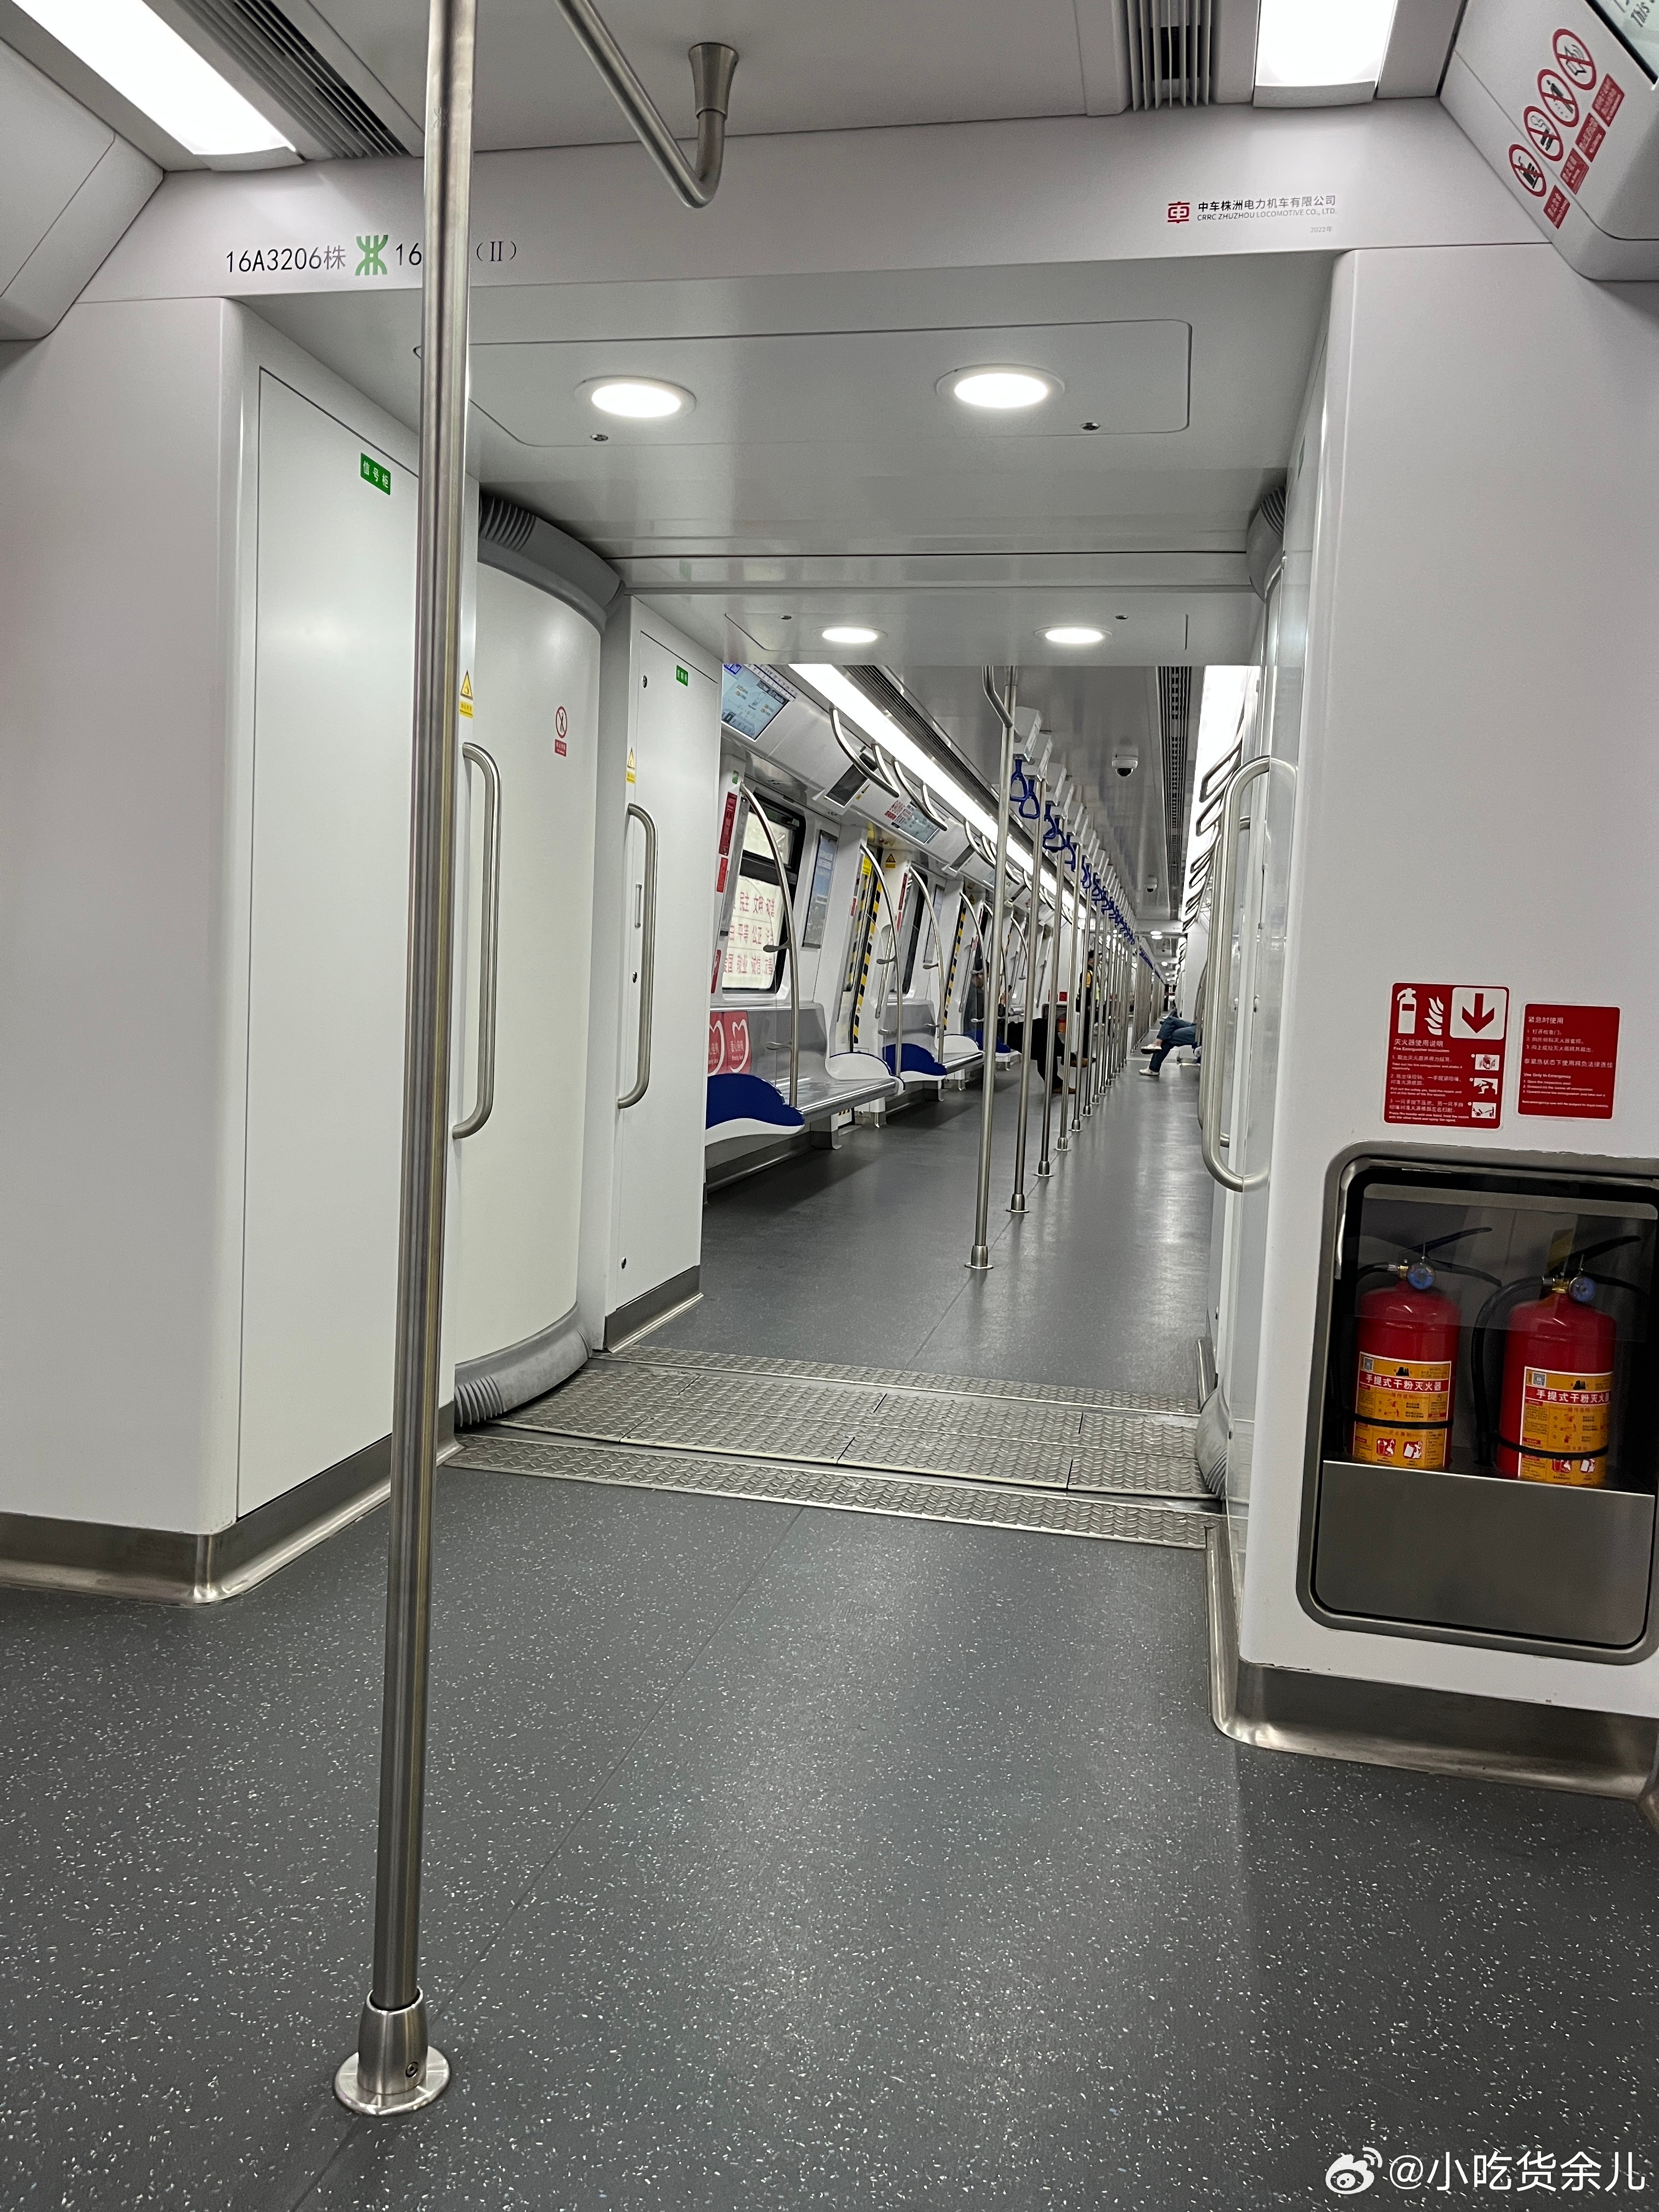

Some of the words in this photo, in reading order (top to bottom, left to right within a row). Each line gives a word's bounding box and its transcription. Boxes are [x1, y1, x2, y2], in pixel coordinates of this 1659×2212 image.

[1198, 195, 1335, 212] 中车株洲电力机车有限公司
[1218, 212, 1255, 220] ZHUZHOU
[1256, 209, 1304, 218] LOCOMOTIVE
[226, 245, 346, 273] 16A3206株
[363, 460, 389, 489] 信号柜
[1528, 1016, 1564, 1024] 紧急时使用
[1394, 1039, 1444, 1047] 灭火器使用说明
[1365, 1373, 1442, 1391] 手提式干粉灭火器
